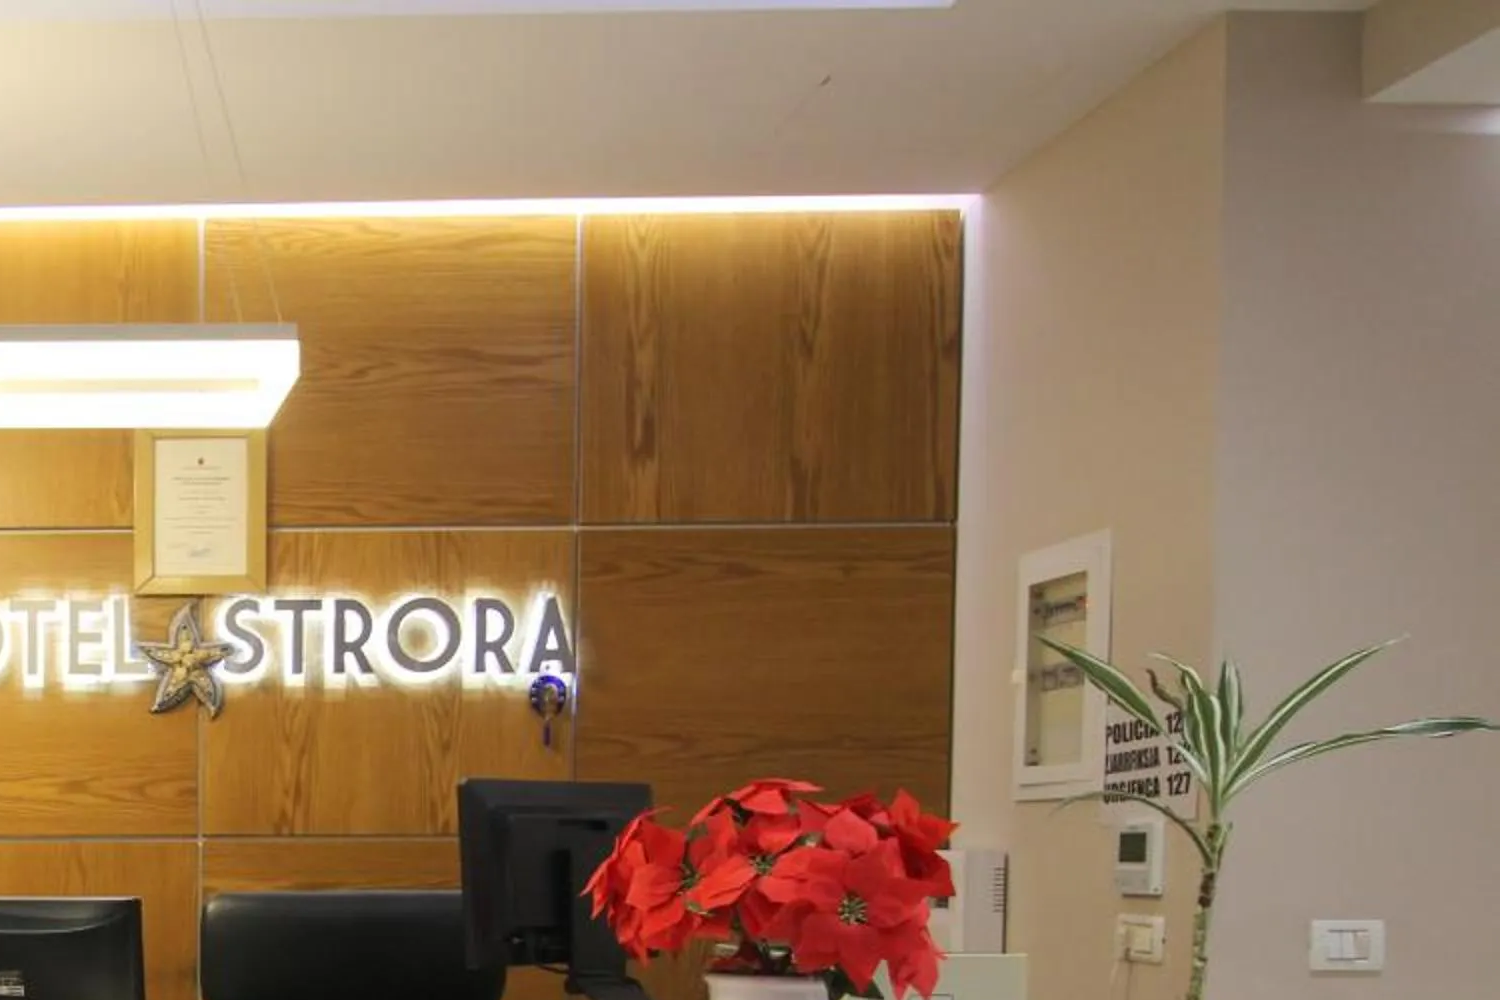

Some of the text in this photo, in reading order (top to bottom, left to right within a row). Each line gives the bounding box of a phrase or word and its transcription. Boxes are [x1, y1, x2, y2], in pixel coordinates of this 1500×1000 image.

[224, 596, 576, 675] STRORA
[1165, 712, 1185, 735] 12
[1167, 772, 1190, 796] 127
